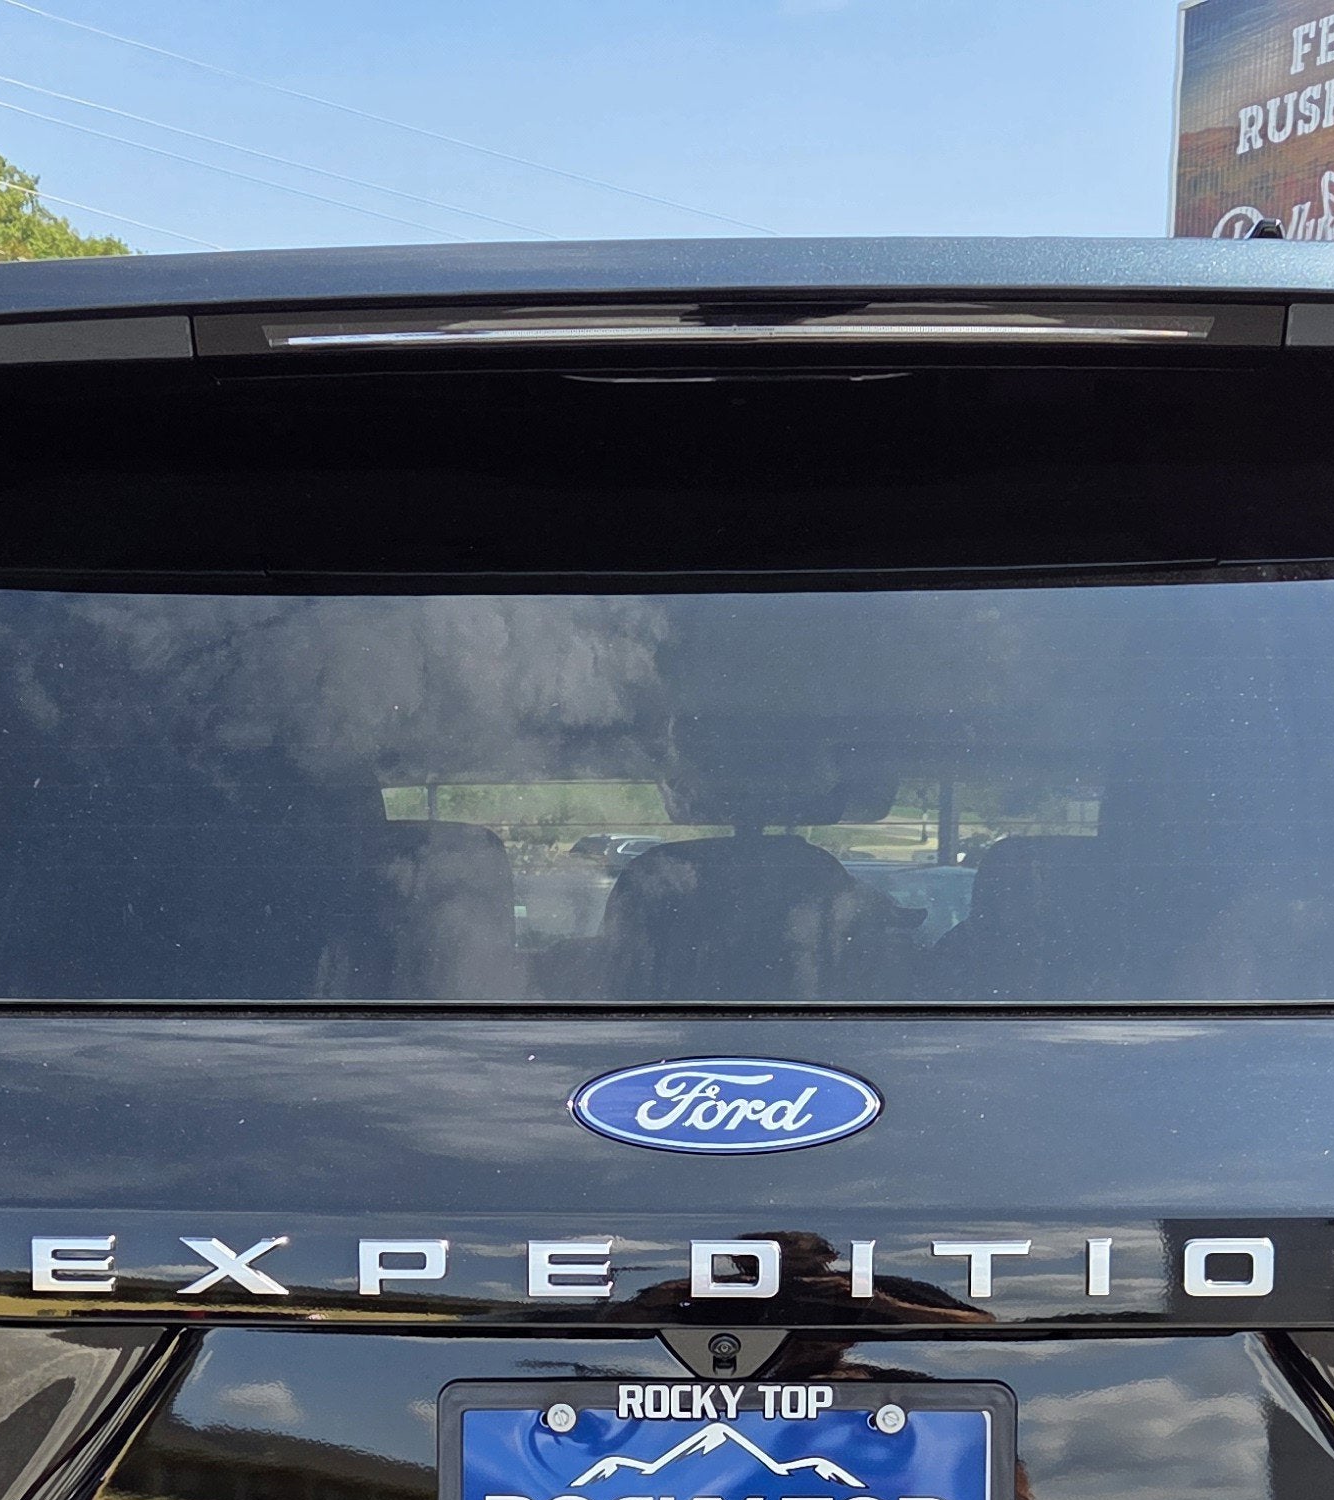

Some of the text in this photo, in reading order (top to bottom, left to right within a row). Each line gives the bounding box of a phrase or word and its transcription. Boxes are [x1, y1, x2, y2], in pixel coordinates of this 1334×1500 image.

[634, 1071, 818, 1131] Ford
[617, 1384, 833, 1419] ROCKY TOP
